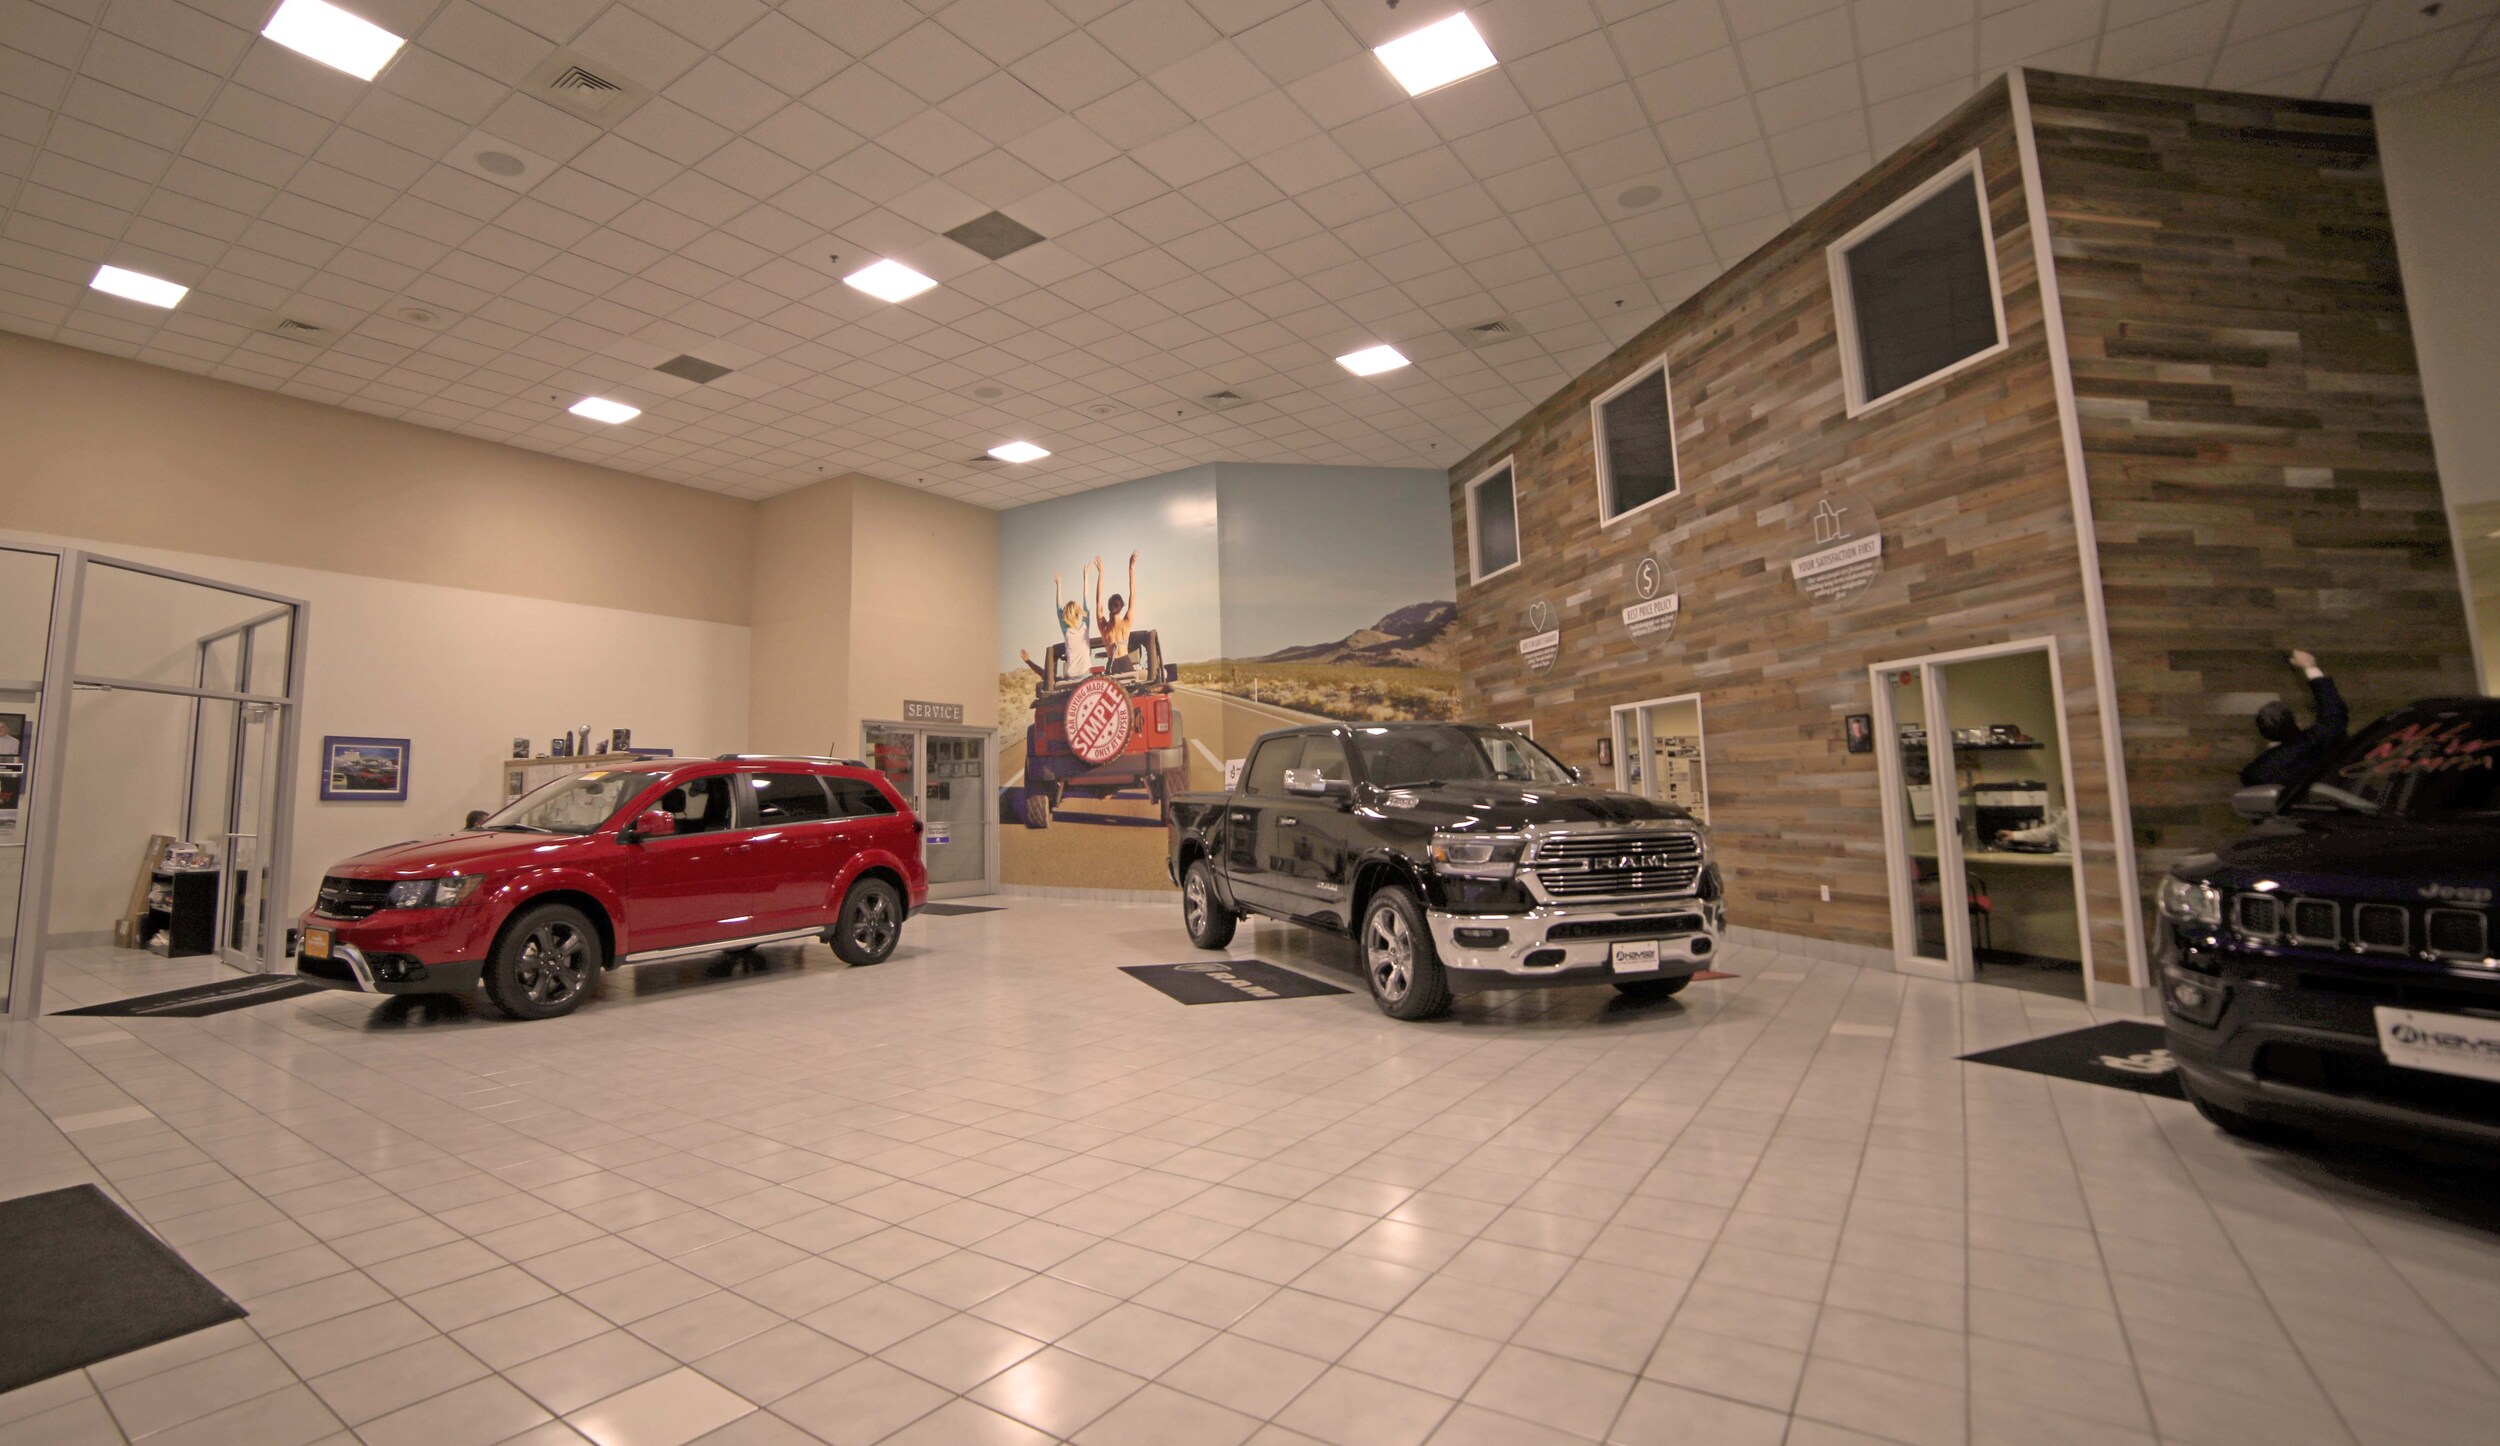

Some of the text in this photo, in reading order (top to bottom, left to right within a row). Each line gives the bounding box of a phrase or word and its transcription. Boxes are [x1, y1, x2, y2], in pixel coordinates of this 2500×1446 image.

[1798, 540, 1875, 573] YOUR SATISFACTION FIRST
[1627, 598, 1672, 621] BEST PRICE POLICY
[908, 703, 960, 720] SERVICE
[1067, 682, 1105, 735] CAR BUYING MADE
[1073, 683, 1123, 756] SIMPLE
[1094, 710, 1128, 758] ONLY AT KAYSER
[1594, 853, 1667, 870] RAM
[1205, 971, 1281, 998] RAM
